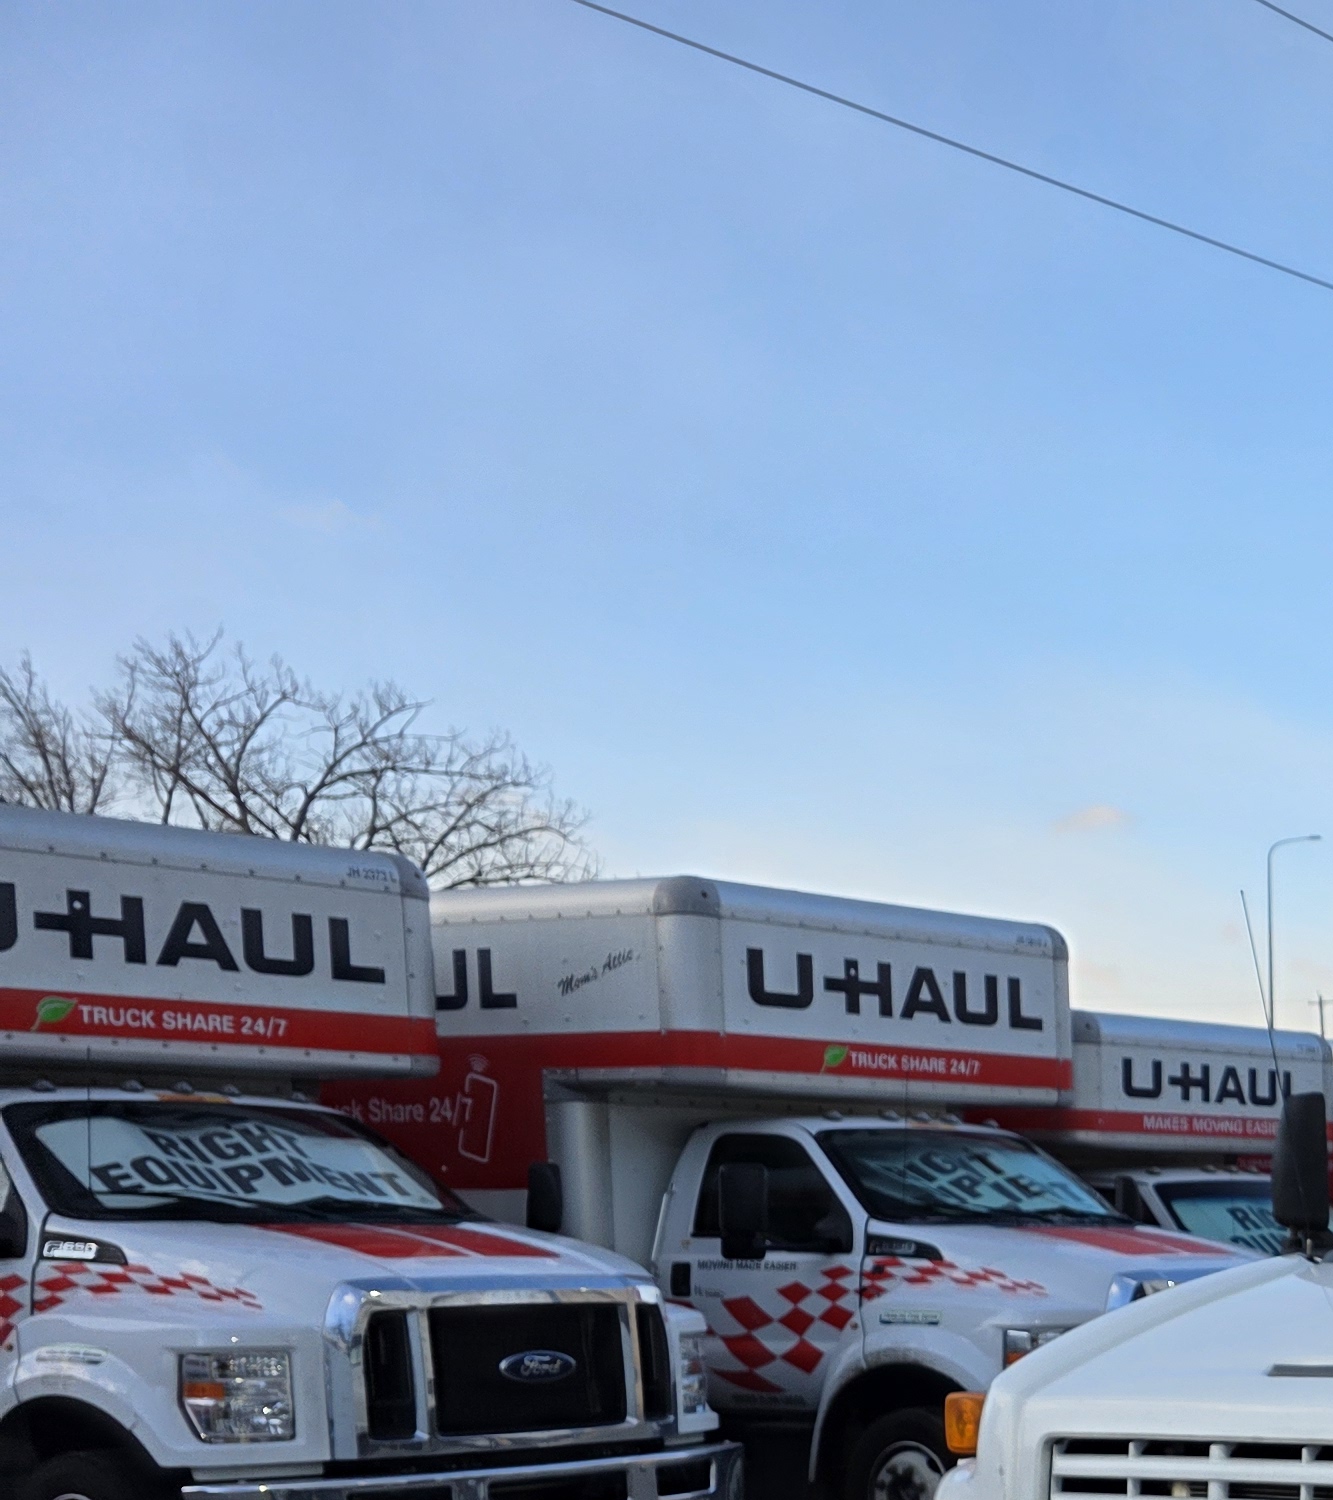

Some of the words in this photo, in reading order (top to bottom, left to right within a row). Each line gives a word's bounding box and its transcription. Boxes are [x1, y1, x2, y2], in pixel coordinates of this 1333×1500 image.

[0, 881, 386, 984] -HAUL
[557, 966, 598, 997] Mom's
[746, 946, 1043, 1031] U-HAUL
[79, 1004, 156, 1029] TRUCK
[162, 1010, 235, 1035] SHARE
[240, 1016, 288, 1039] 24/7
[850, 1051, 898, 1070] TRUCK
[901, 1055, 946, 1074] SHARE
[950, 1058, 981, 1076] 24/7
[368, 1097, 425, 1123] Share
[429, 1091, 473, 1127] 24/7
[1143, 1114, 1188, 1131] MAKES
[1192, 1117, 1243, 1135] MOVING
[1246, 1119, 1278, 1135] EASIE
[147, 1121, 312, 1164] RIGHT
[91, 1154, 412, 1197] EQUIPMENT
[521, 1355, 562, 1376] Ford
